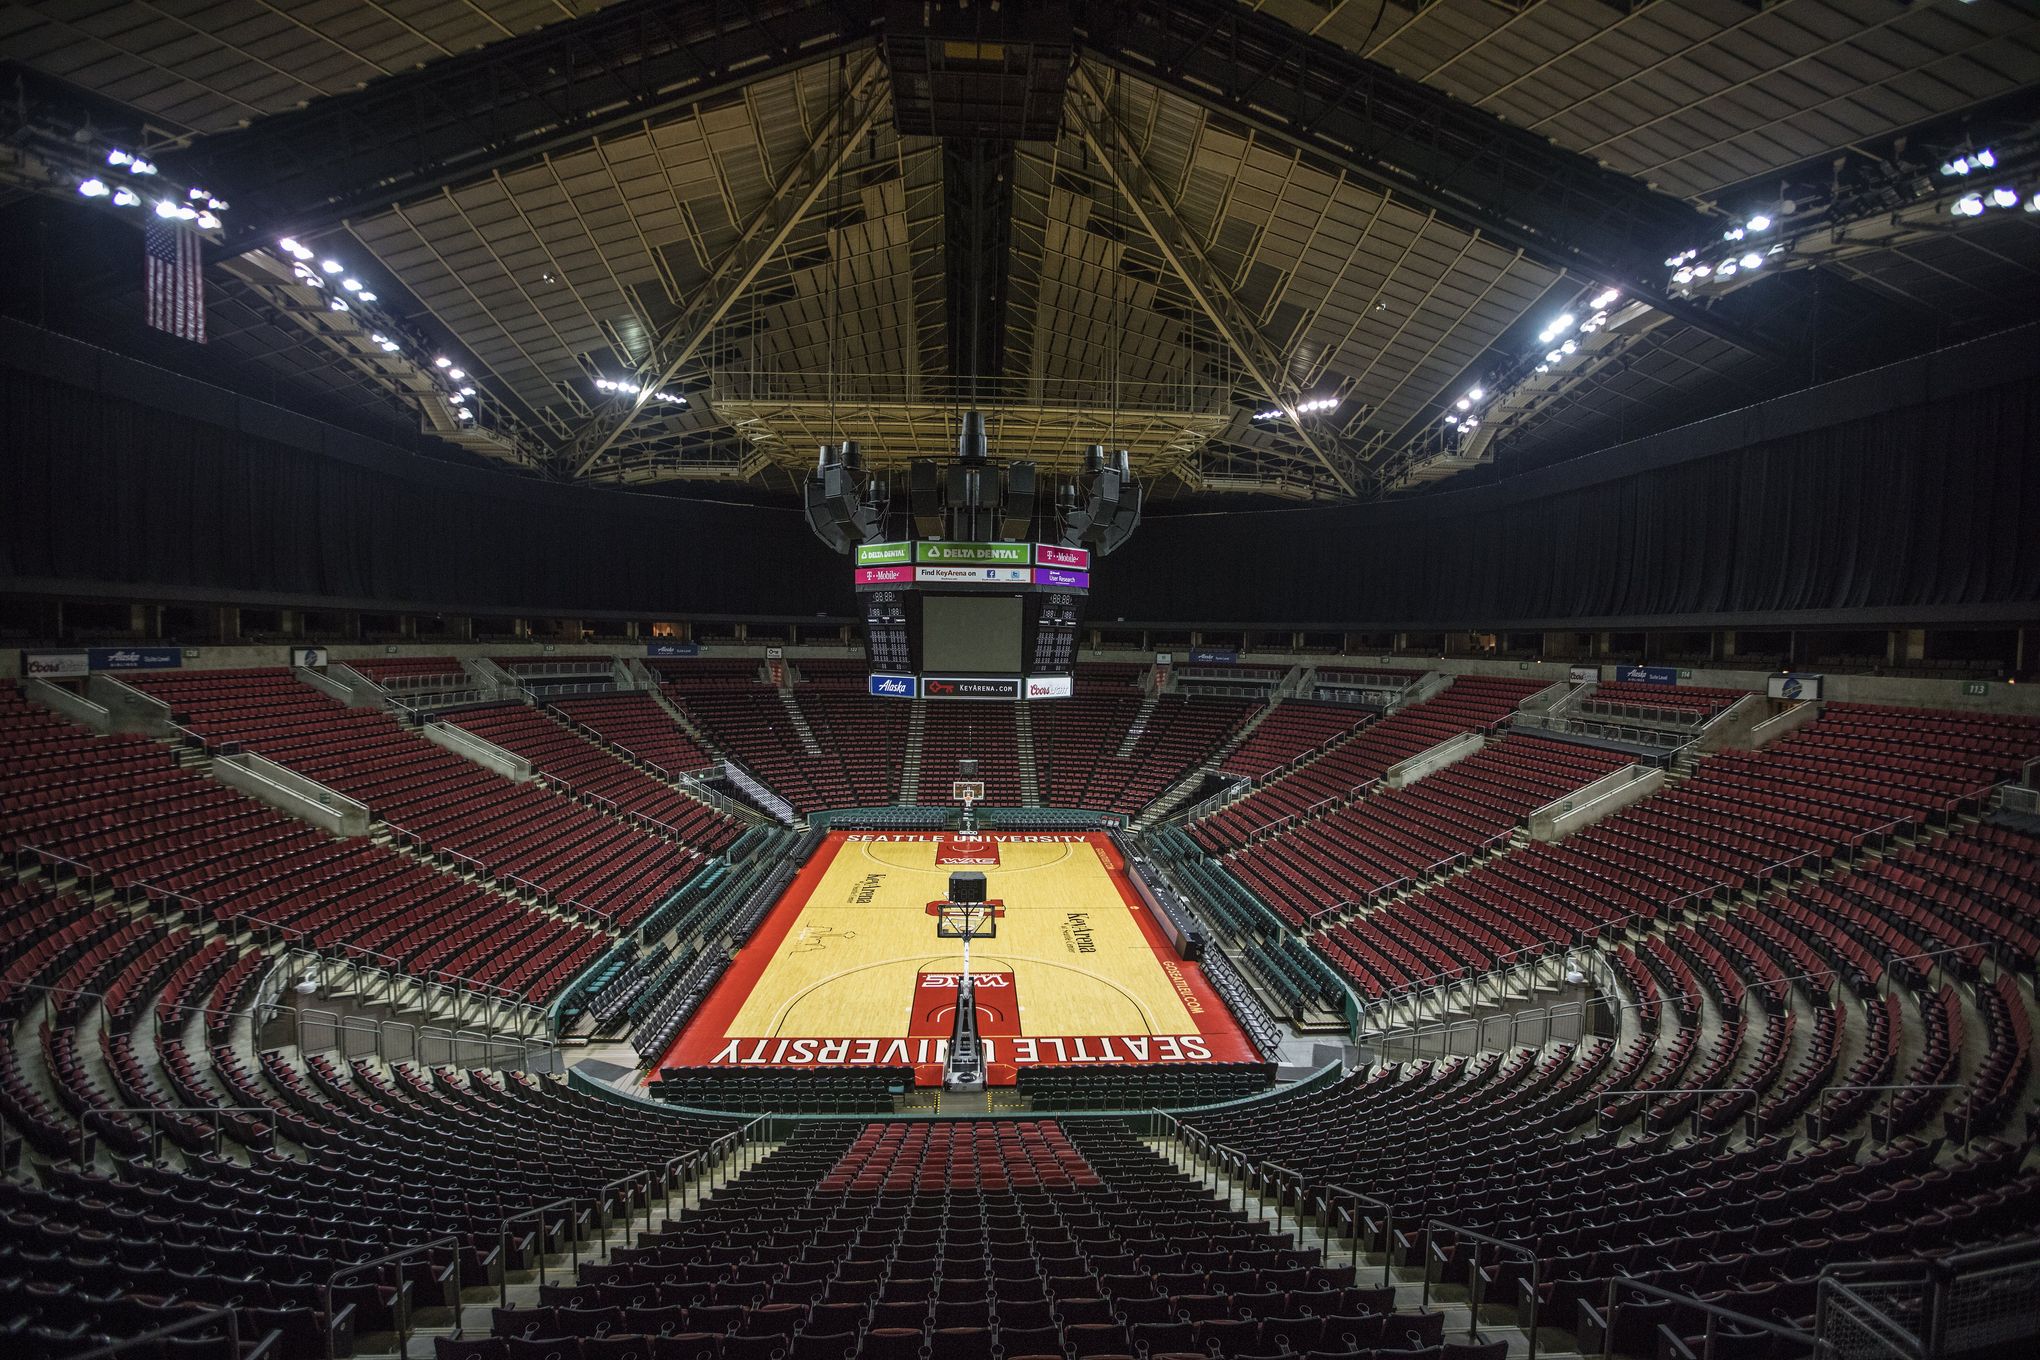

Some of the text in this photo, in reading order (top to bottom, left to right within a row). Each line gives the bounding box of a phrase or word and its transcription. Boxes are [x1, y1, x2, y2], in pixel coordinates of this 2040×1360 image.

[884, 550, 905, 558] DENTAL
[943, 549, 1019, 559] DELTA DENTAL
[936, 569, 967, 578] KeyArena
[28, 660, 60, 673] Coors
[1627, 669, 1647, 679] Alaska
[878, 679, 907, 694] Alaska
[1030, 683, 1050, 695] Coors
[1969, 685, 1985, 694] 113
[847, 835, 1087, 843] SEATTLE UNIVERSITY
[940, 857, 996, 865] WAC
[1067, 912, 1097, 954] KeyArena
[1012, 1036, 1212, 1063] SEATTLE
